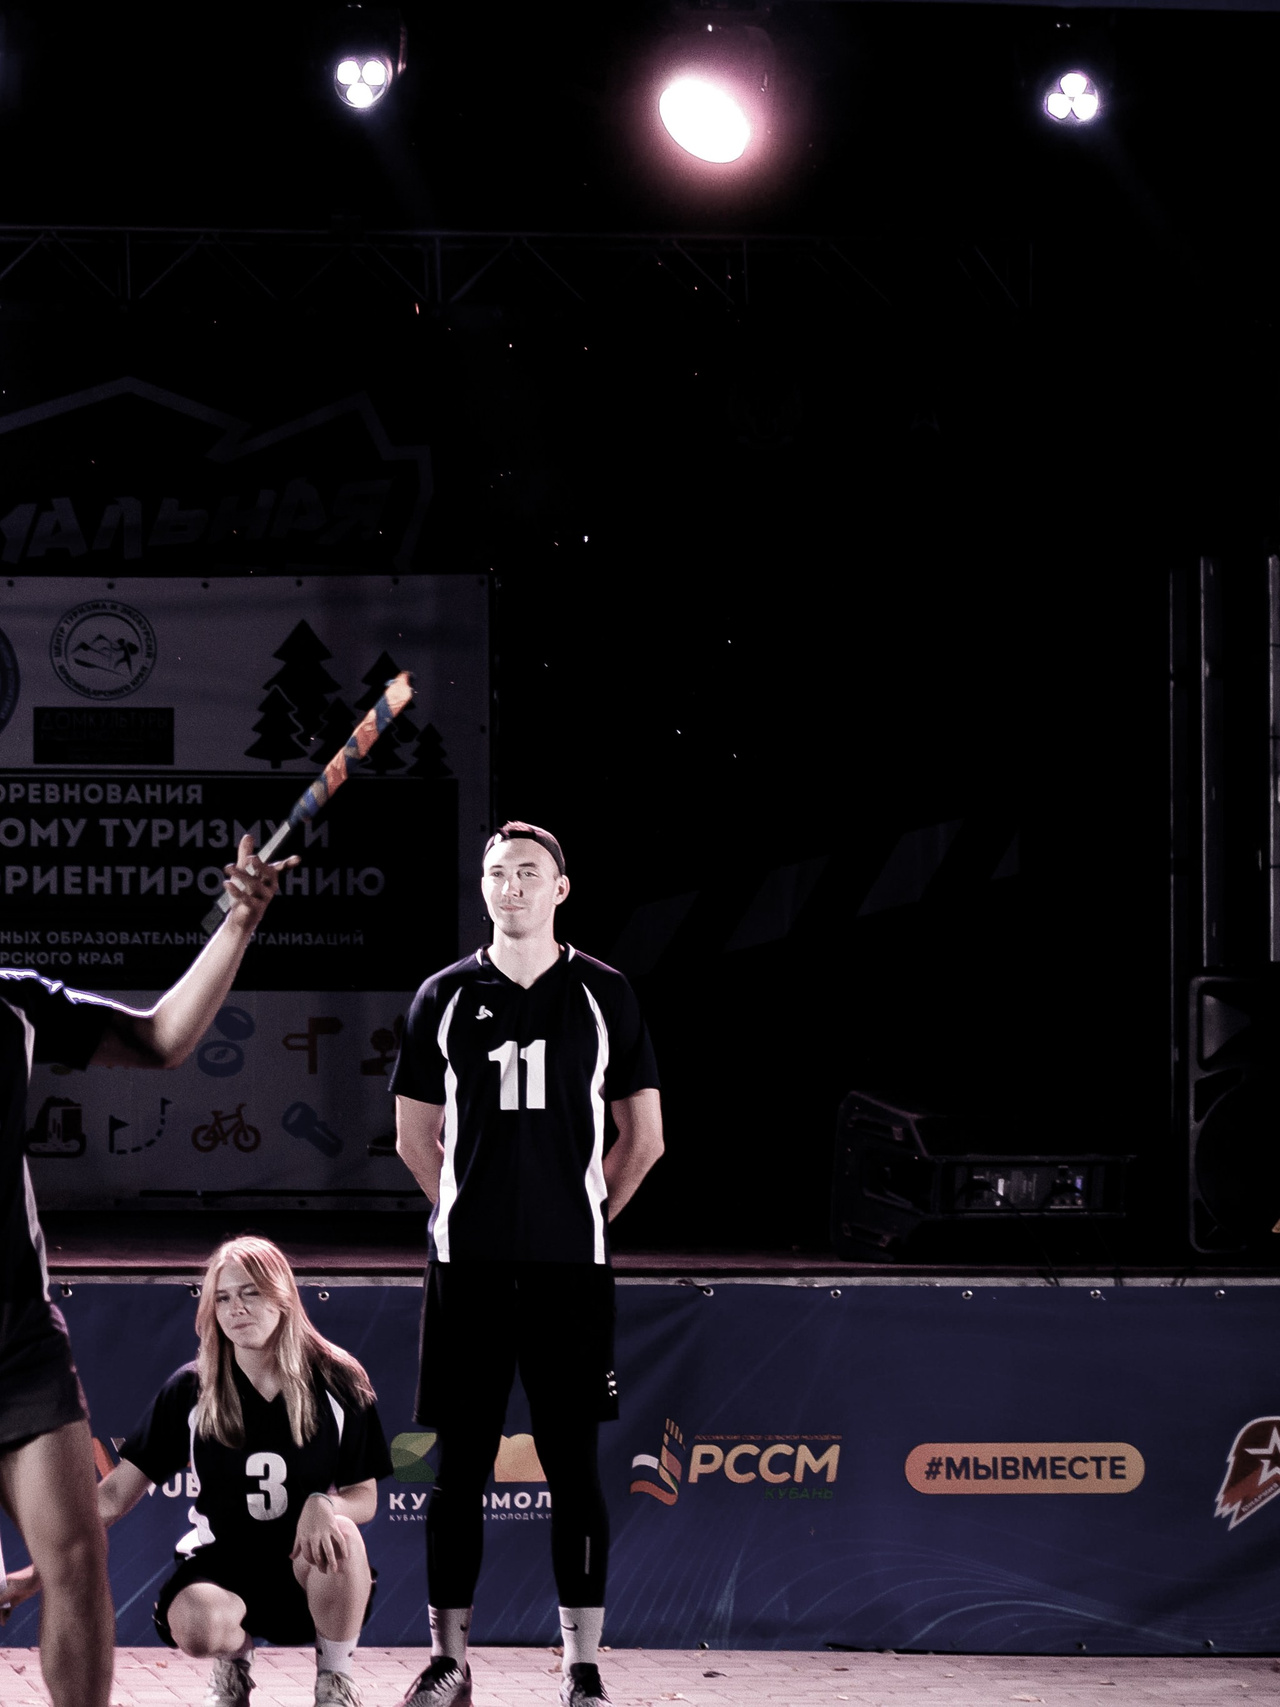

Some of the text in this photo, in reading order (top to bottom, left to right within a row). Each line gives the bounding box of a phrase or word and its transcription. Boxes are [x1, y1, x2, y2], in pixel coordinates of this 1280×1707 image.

[303, 819, 330, 848] И
[77, 951, 125, 966] КРАЯ
[486, 1039, 547, 1111] 11
[688, 1443, 841, 1484] РССМ
[923, 1456, 1126, 1480] #МЫВМЕСТЕ
[245, 1452, 288, 1521] 3
[763, 1487, 834, 1500] КУБАНЬ
